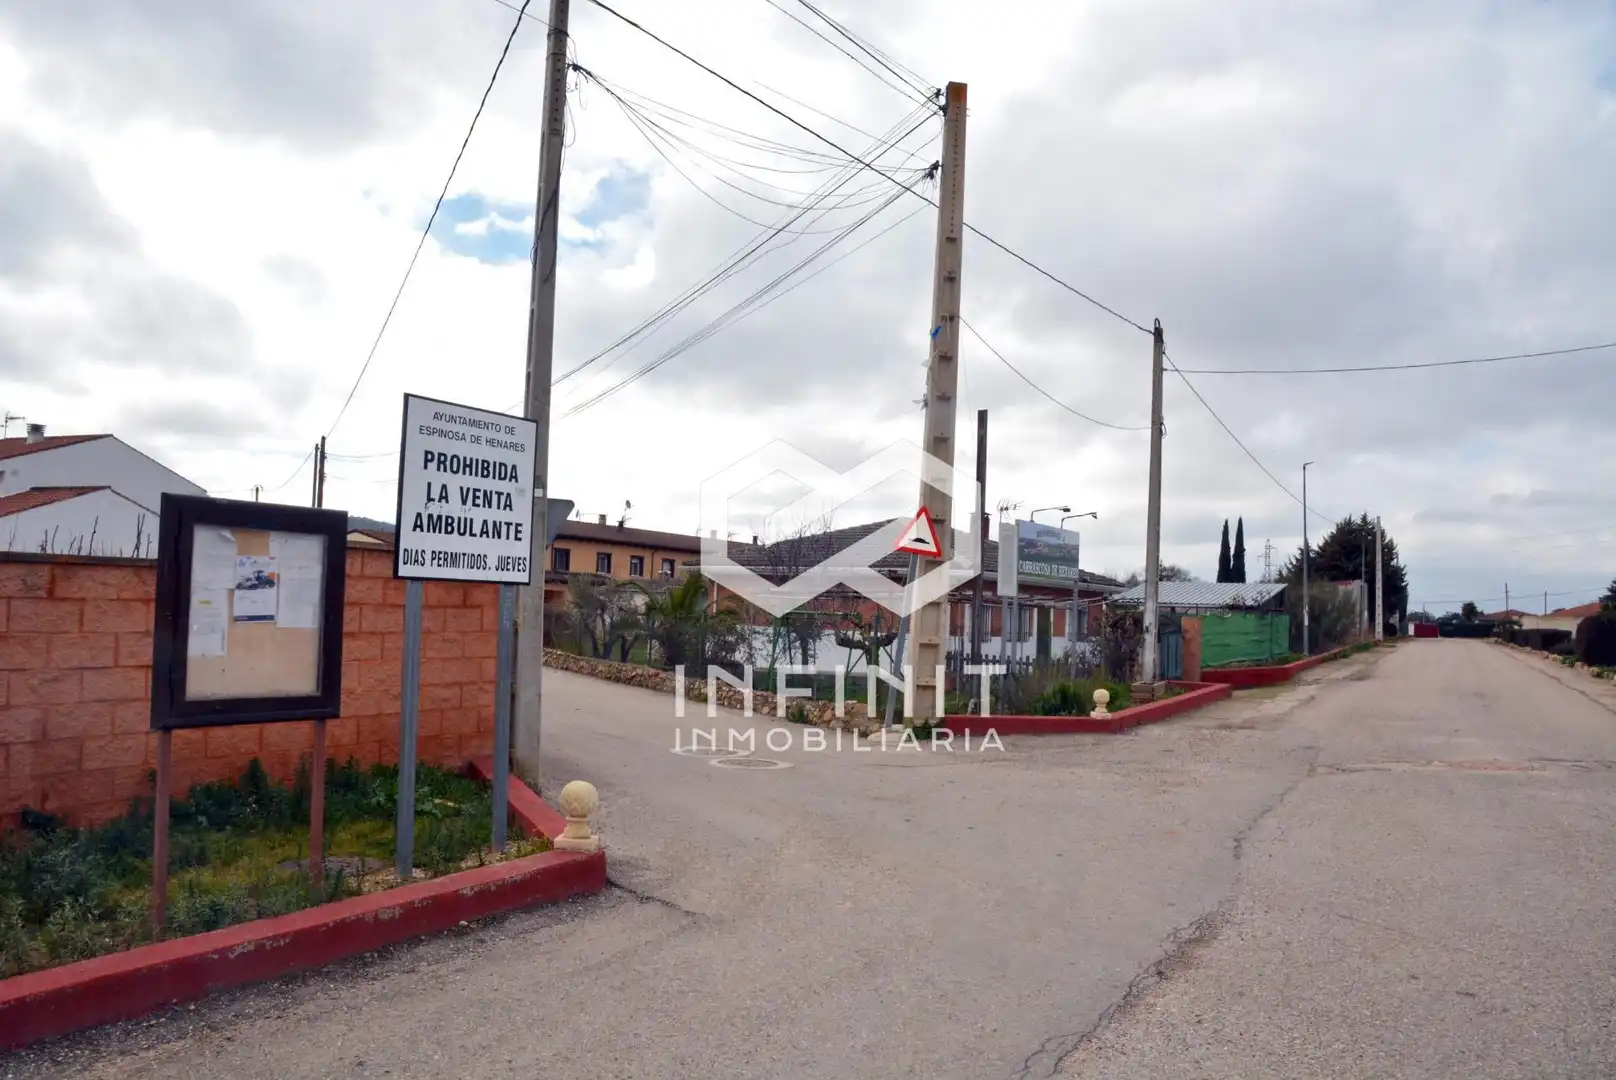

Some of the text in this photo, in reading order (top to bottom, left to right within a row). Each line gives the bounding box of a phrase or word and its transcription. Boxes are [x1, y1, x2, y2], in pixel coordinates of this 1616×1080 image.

[433, 411, 516, 436] AYUNTAMIENTO DE
[419, 425, 526, 453] ESPINOSA DE HENARES
[423, 449, 519, 483] PROHIBIDA
[426, 481, 514, 511] LA VENTA
[412, 511, 523, 542] AMBULANTE
[402, 548, 426, 567] DIAS
[495, 555, 527, 573] JUEVES
